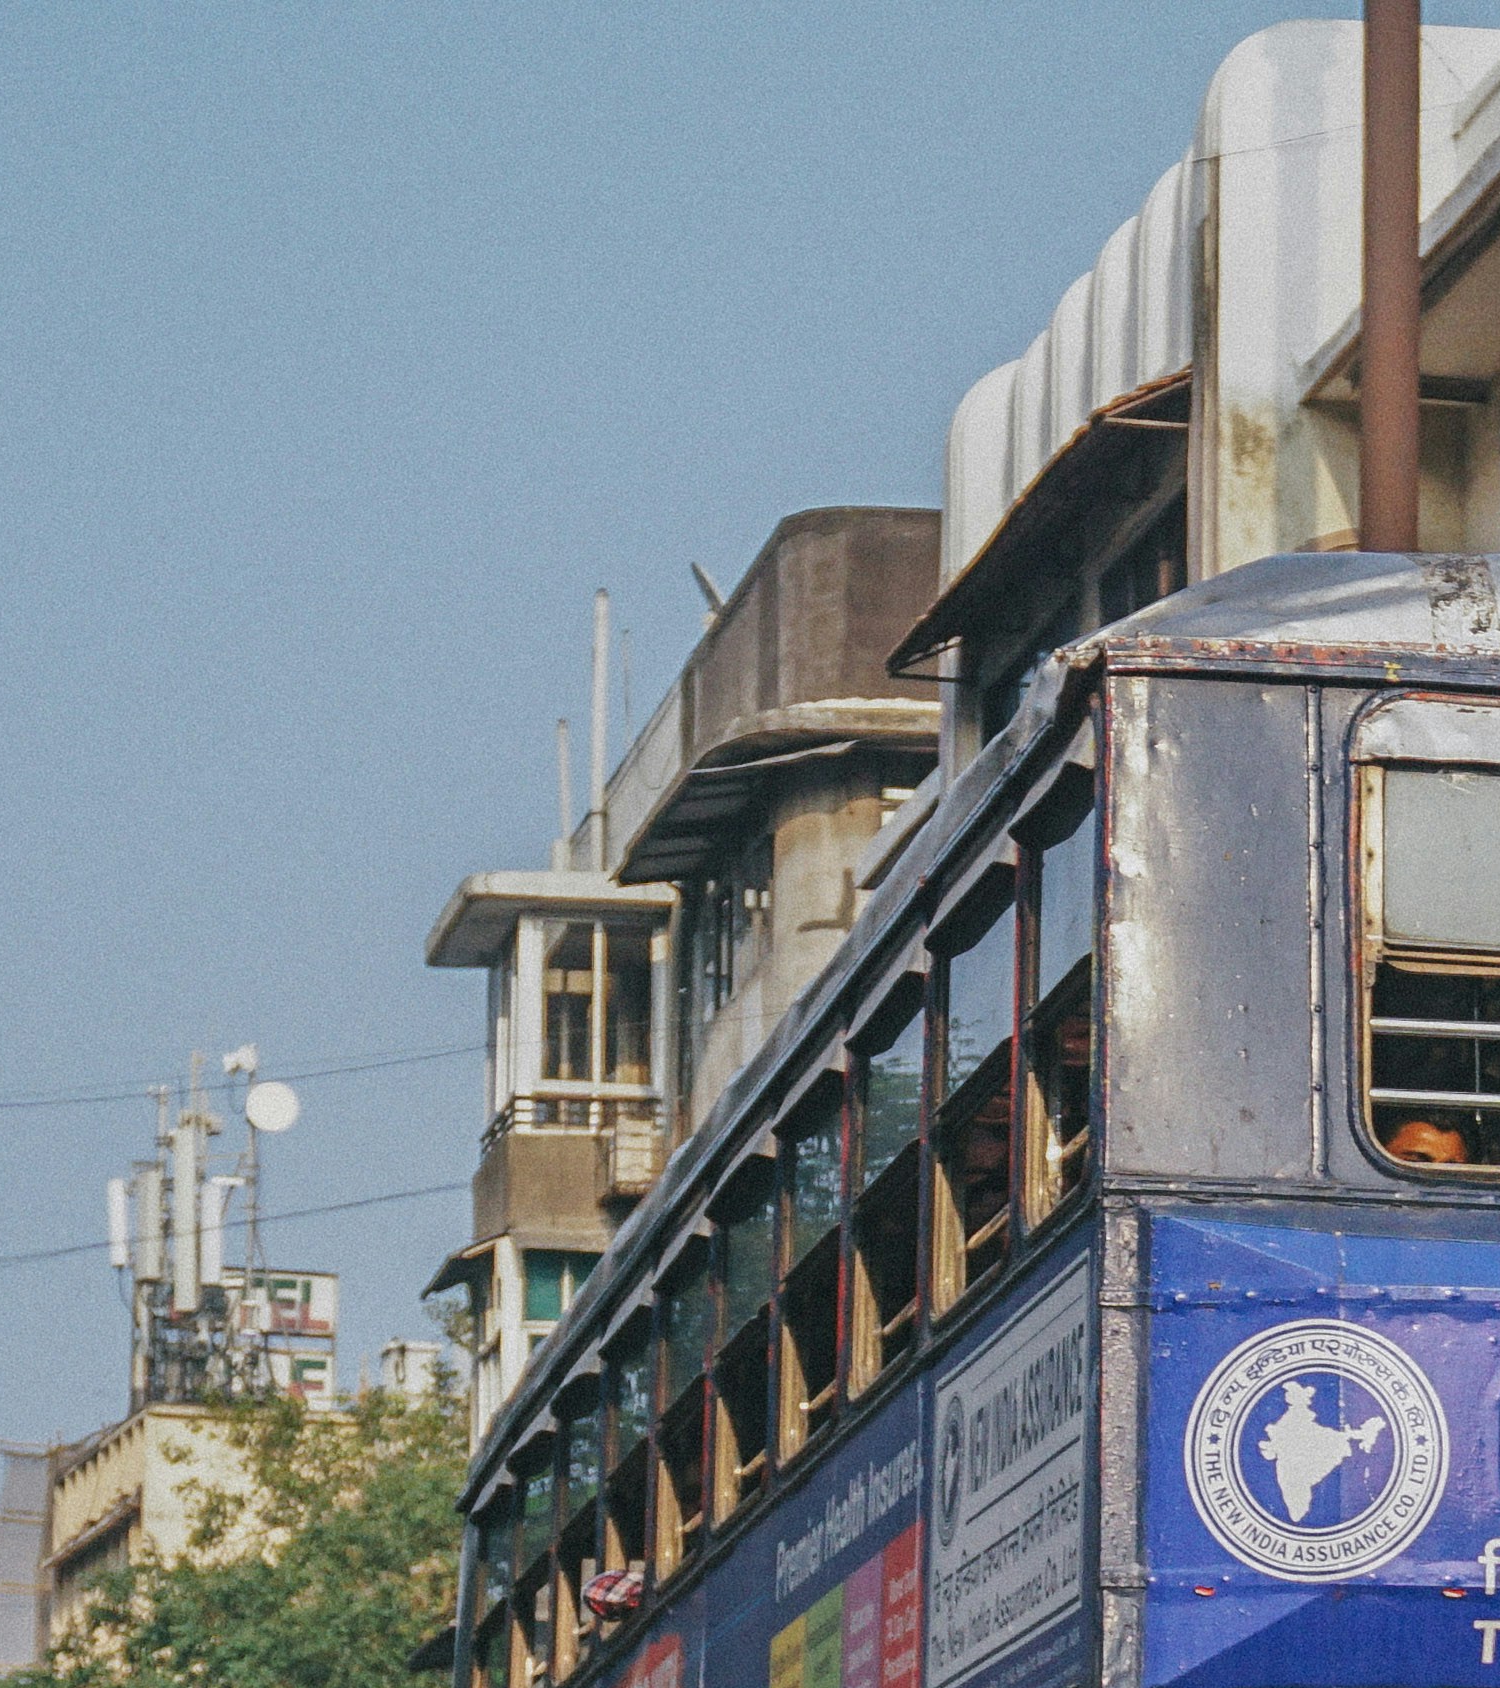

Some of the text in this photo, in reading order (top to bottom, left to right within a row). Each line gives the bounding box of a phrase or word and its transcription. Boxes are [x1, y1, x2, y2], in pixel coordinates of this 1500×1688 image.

[1204, 1450, 1222, 1485] THE
[1211, 1485, 1245, 1527] NEW
[1241, 1521, 1288, 1560] INDIA
[1291, 1515, 1398, 1564] ASSURANCE
